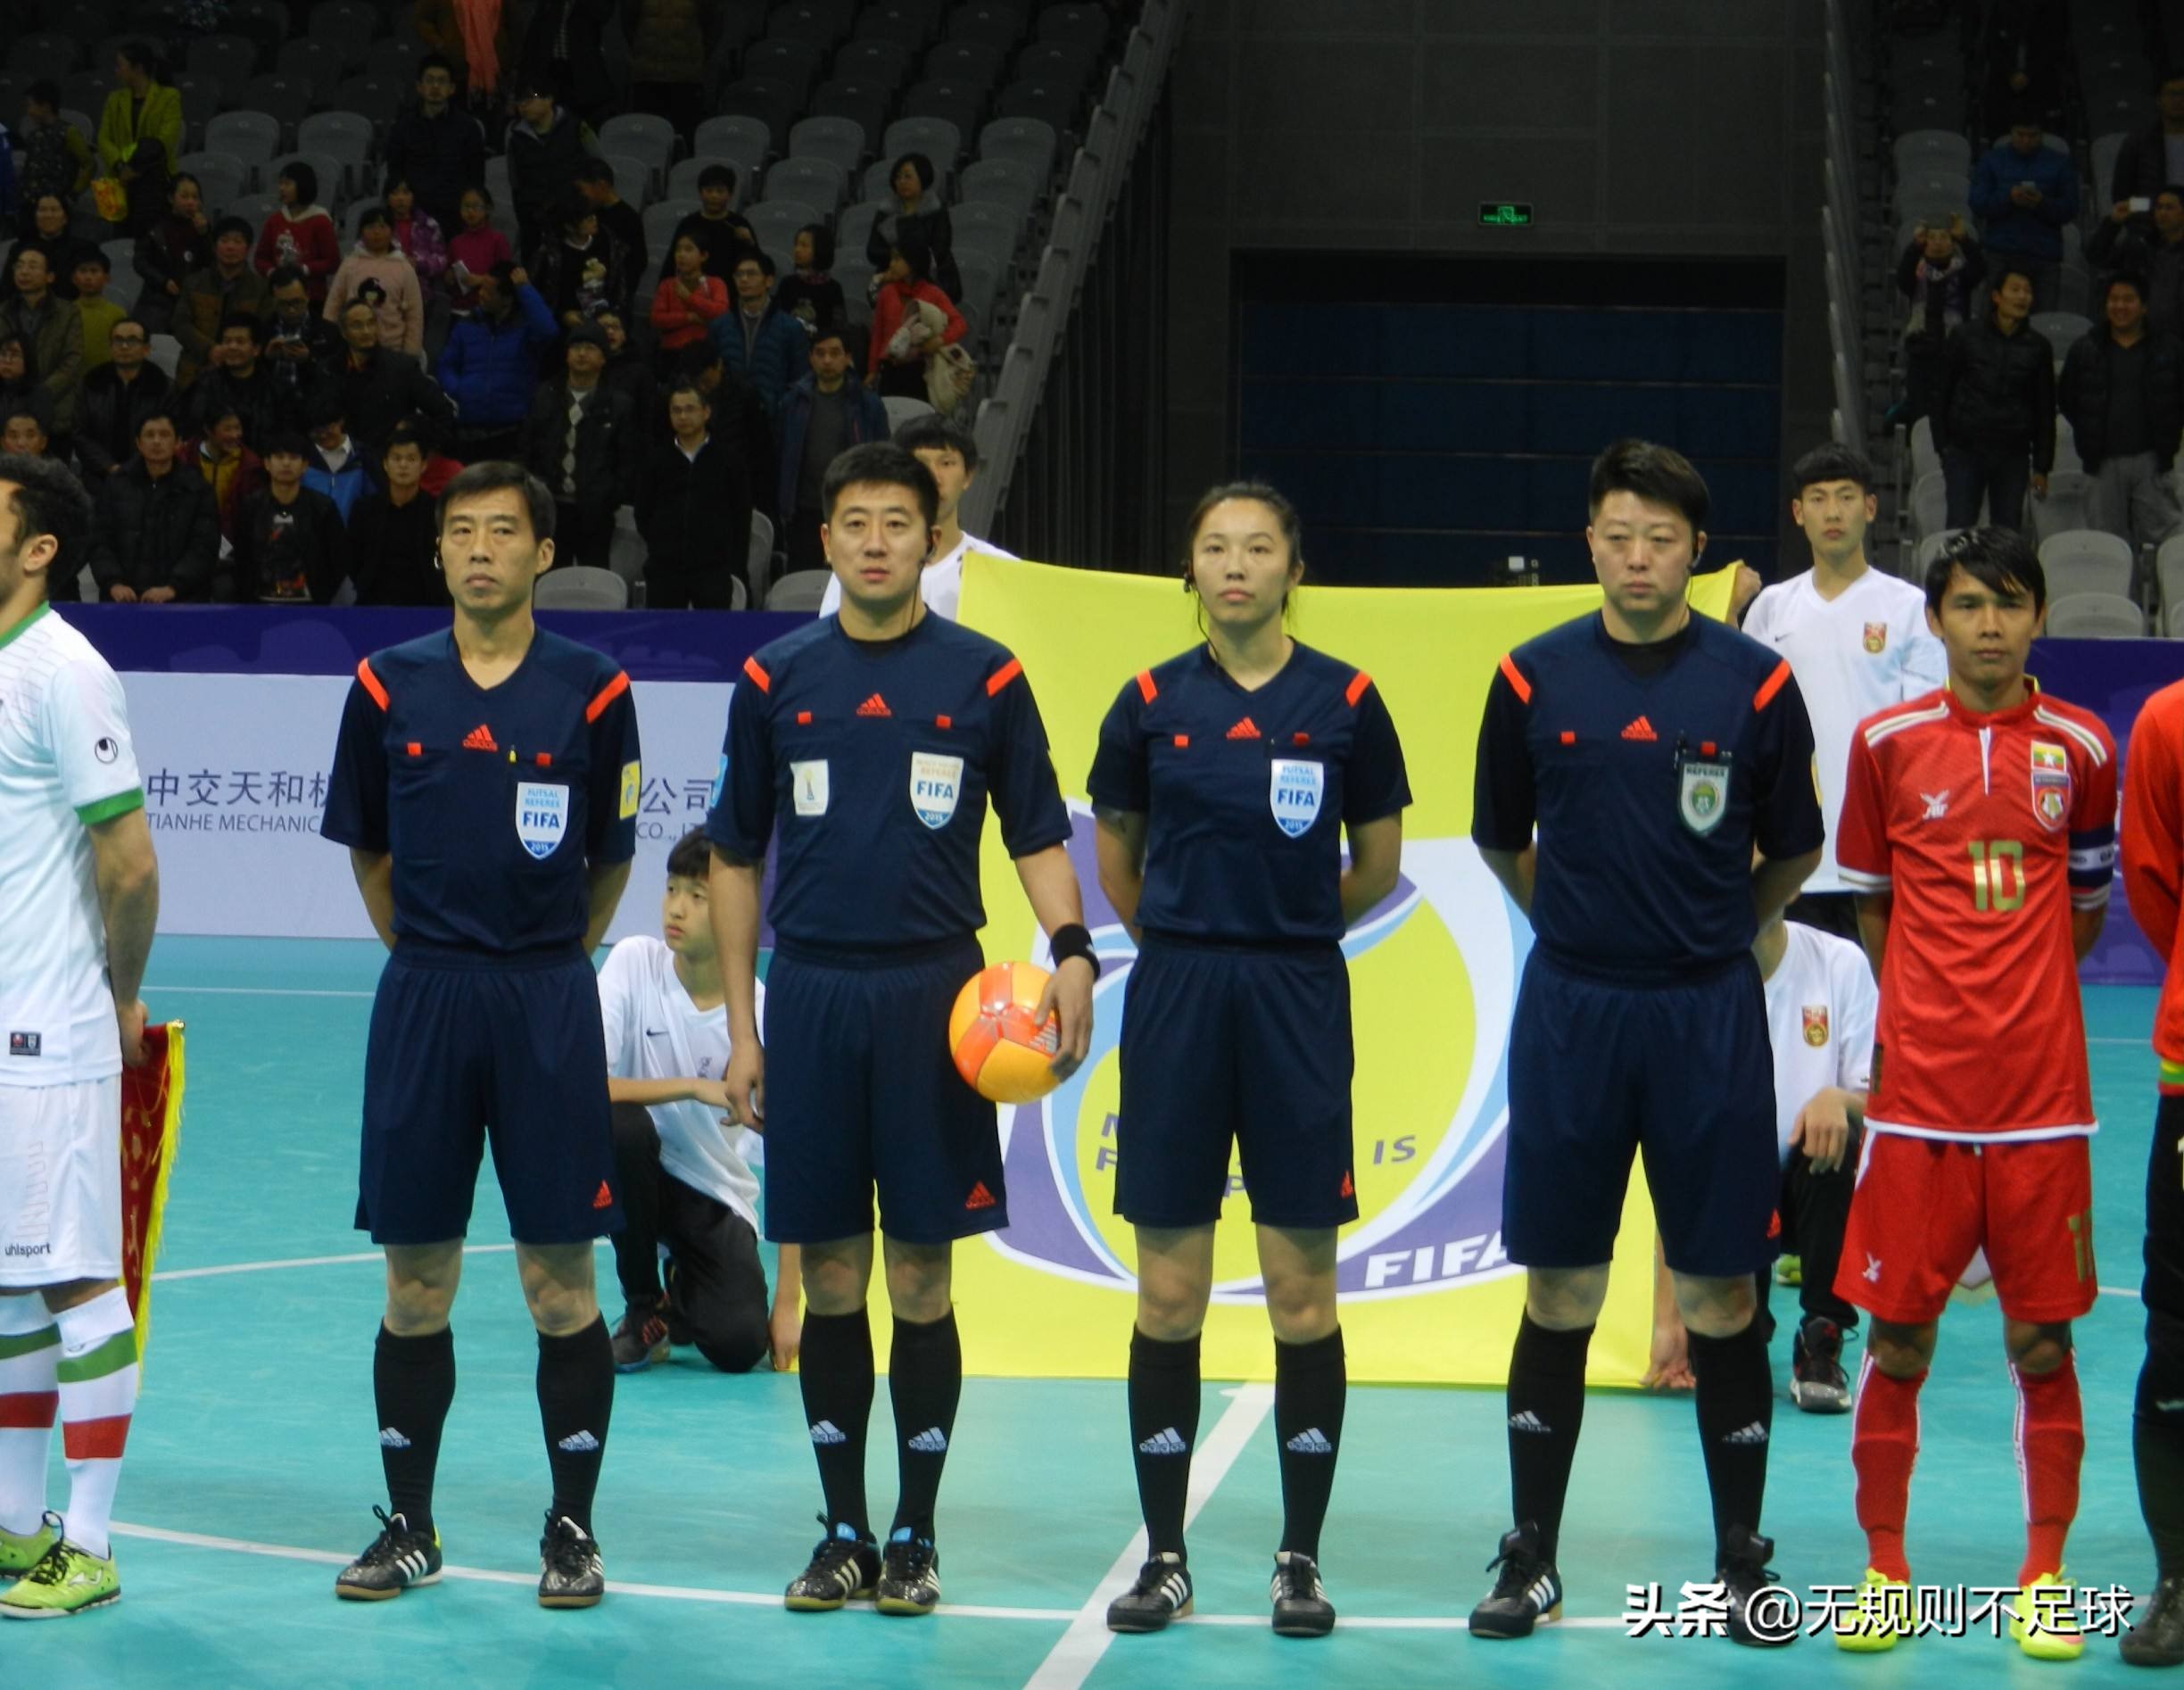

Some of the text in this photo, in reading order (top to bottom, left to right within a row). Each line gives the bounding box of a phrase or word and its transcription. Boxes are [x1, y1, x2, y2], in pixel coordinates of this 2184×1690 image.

[641, 777, 716, 815] 公司
[917, 780, 954, 799] FIFA
[1278, 788, 1315, 807] FIFA
[146, 812, 214, 832] TIANHE
[523, 811, 560, 829] FIFA
[1968, 841, 2026, 911] 10
[1373, 1134, 1417, 1166] IS
[4, 1242, 51, 1258] uhlsport
[1364, 1230, 1508, 1289] FIFA
